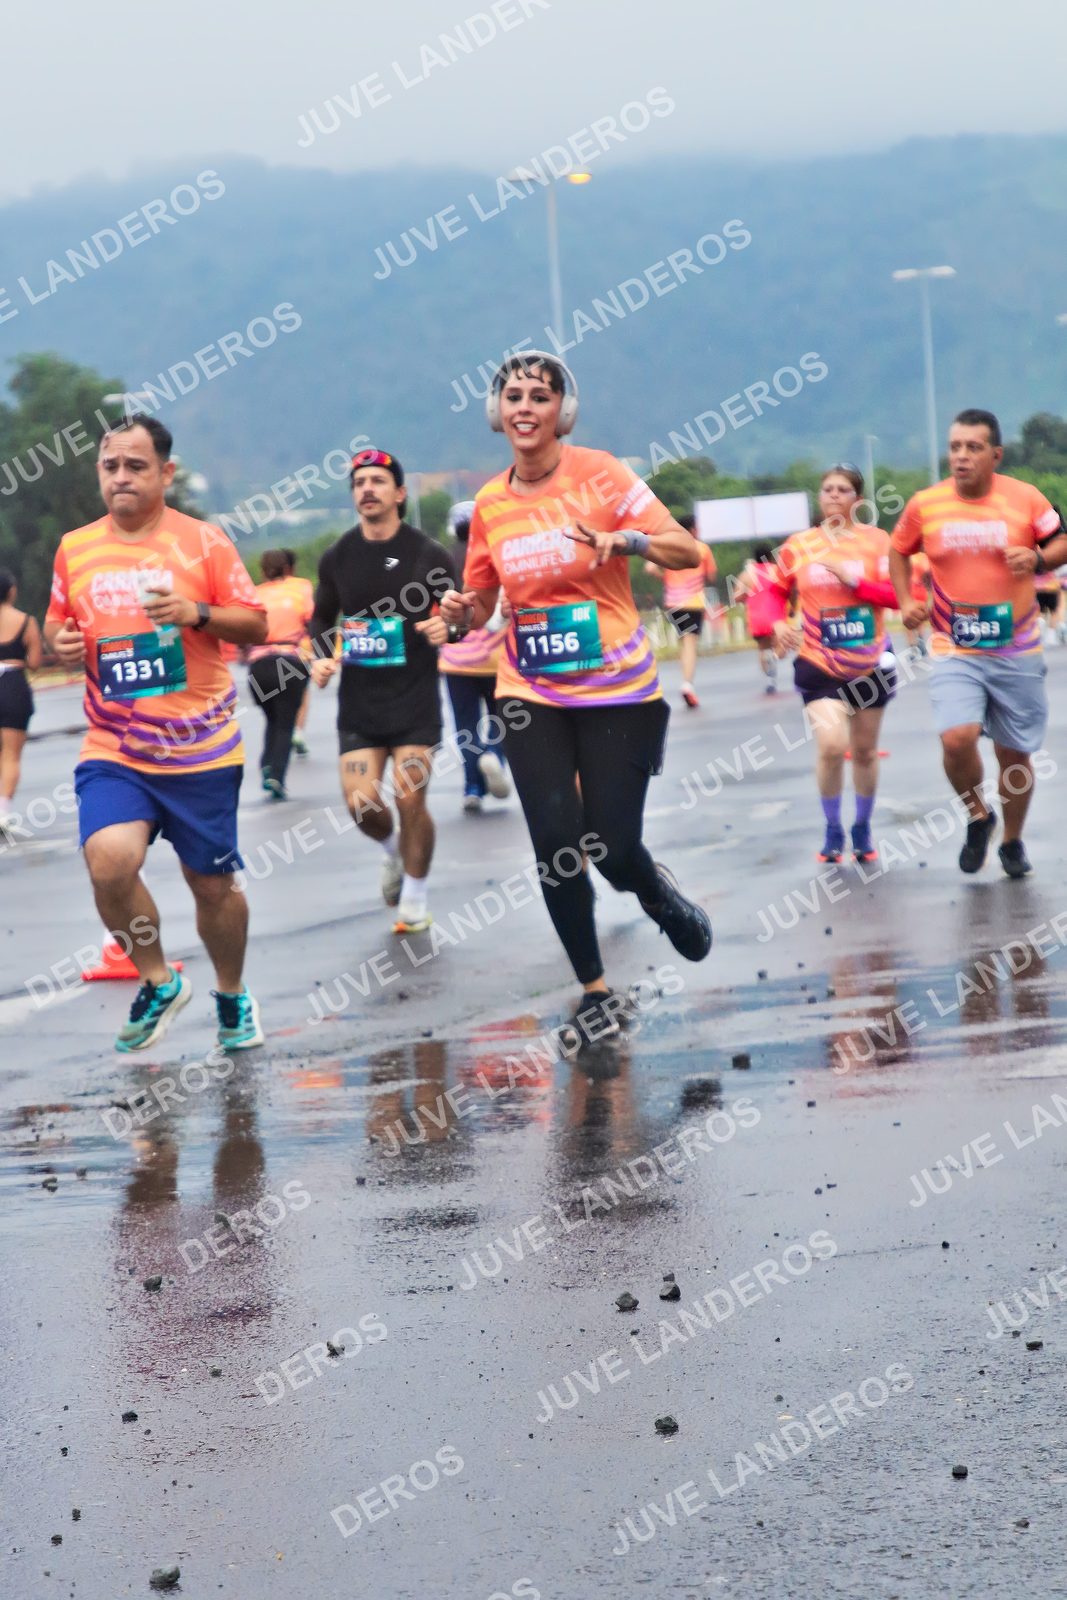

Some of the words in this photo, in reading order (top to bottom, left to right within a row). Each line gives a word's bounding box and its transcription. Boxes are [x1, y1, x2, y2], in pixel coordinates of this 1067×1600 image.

[572, 606, 591, 622] 10K
[350, 637, 387, 654] 1570
[526, 631, 580, 656] 1156
[112, 657, 166, 683] 1331
